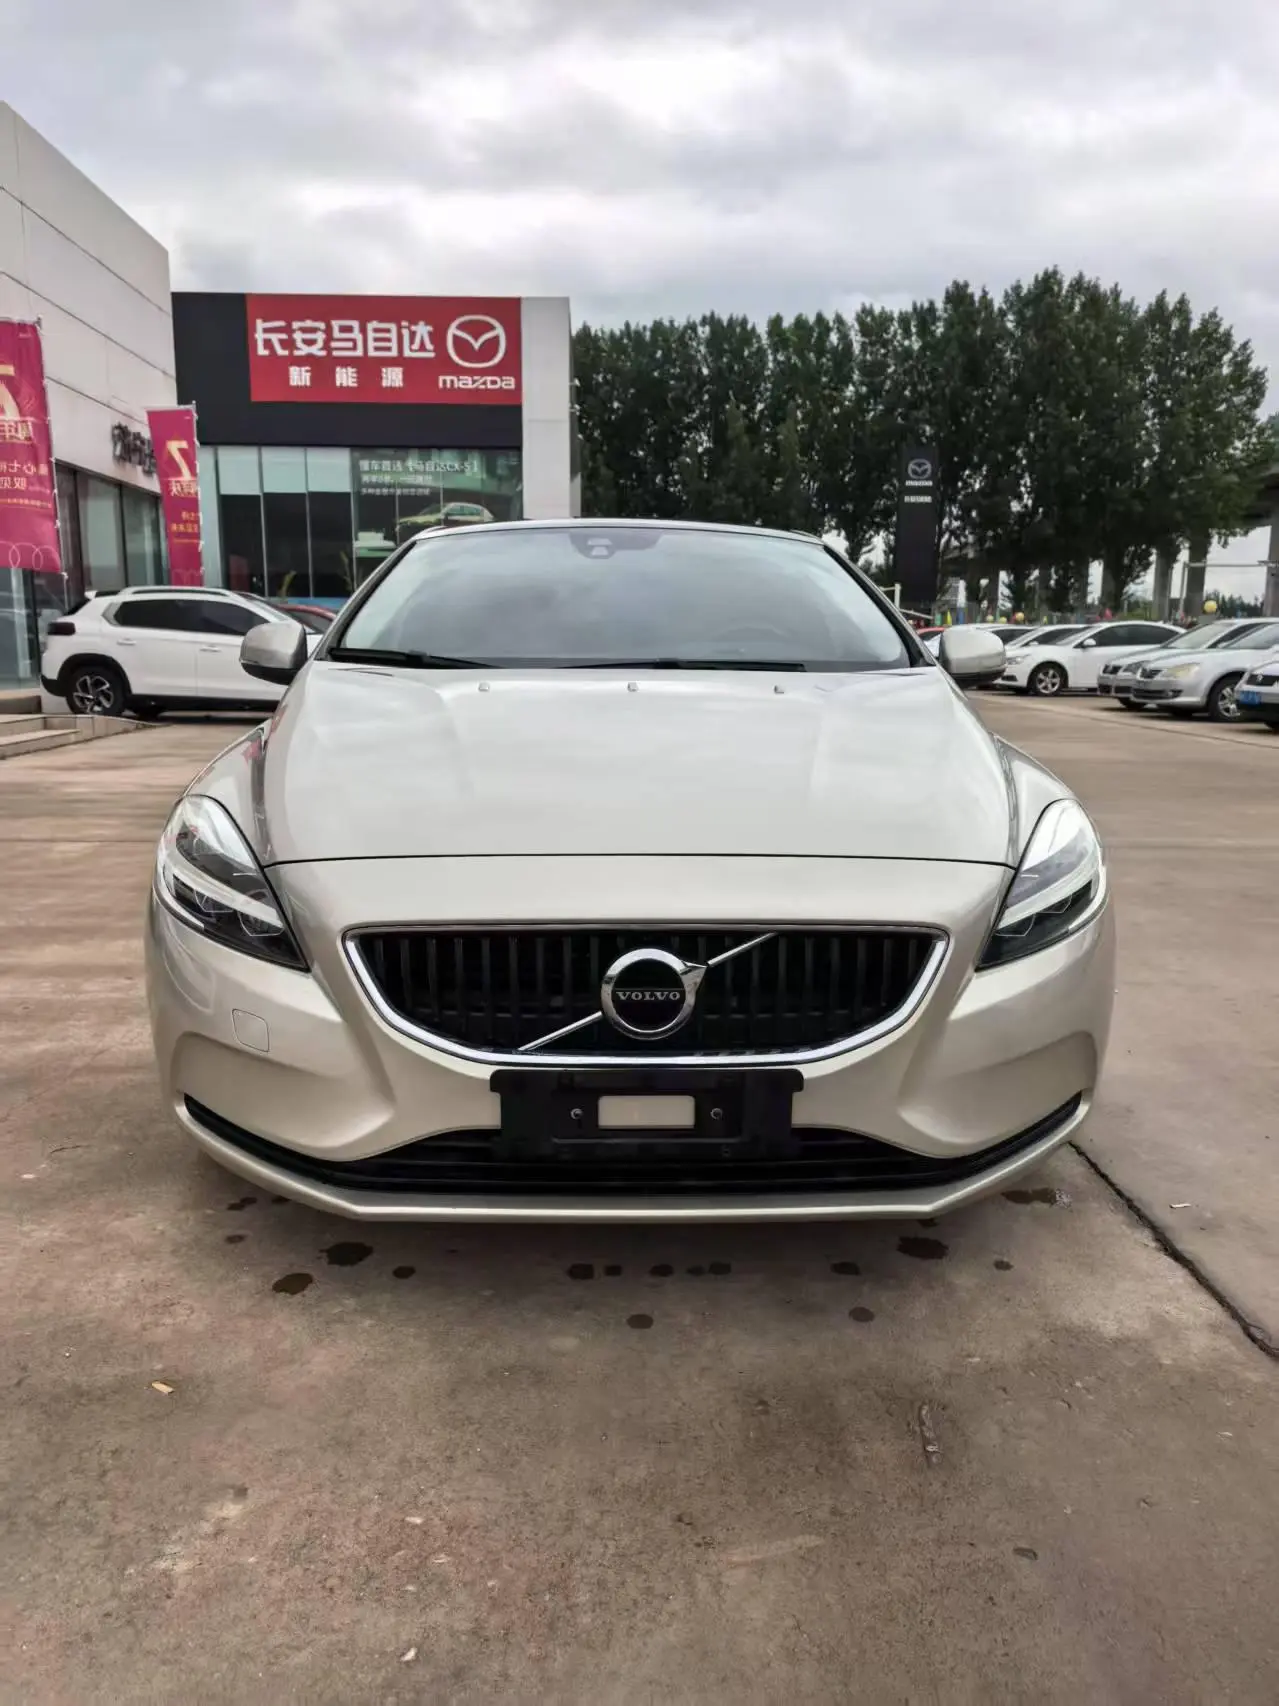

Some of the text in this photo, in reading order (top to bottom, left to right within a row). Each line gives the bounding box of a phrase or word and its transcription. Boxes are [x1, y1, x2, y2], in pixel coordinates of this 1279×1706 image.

[255, 319, 436, 358] 长安马自达
[288, 366, 404, 388] 新能源
[438, 375, 516, 389] mazda
[616, 991, 681, 1001] VOLVO
